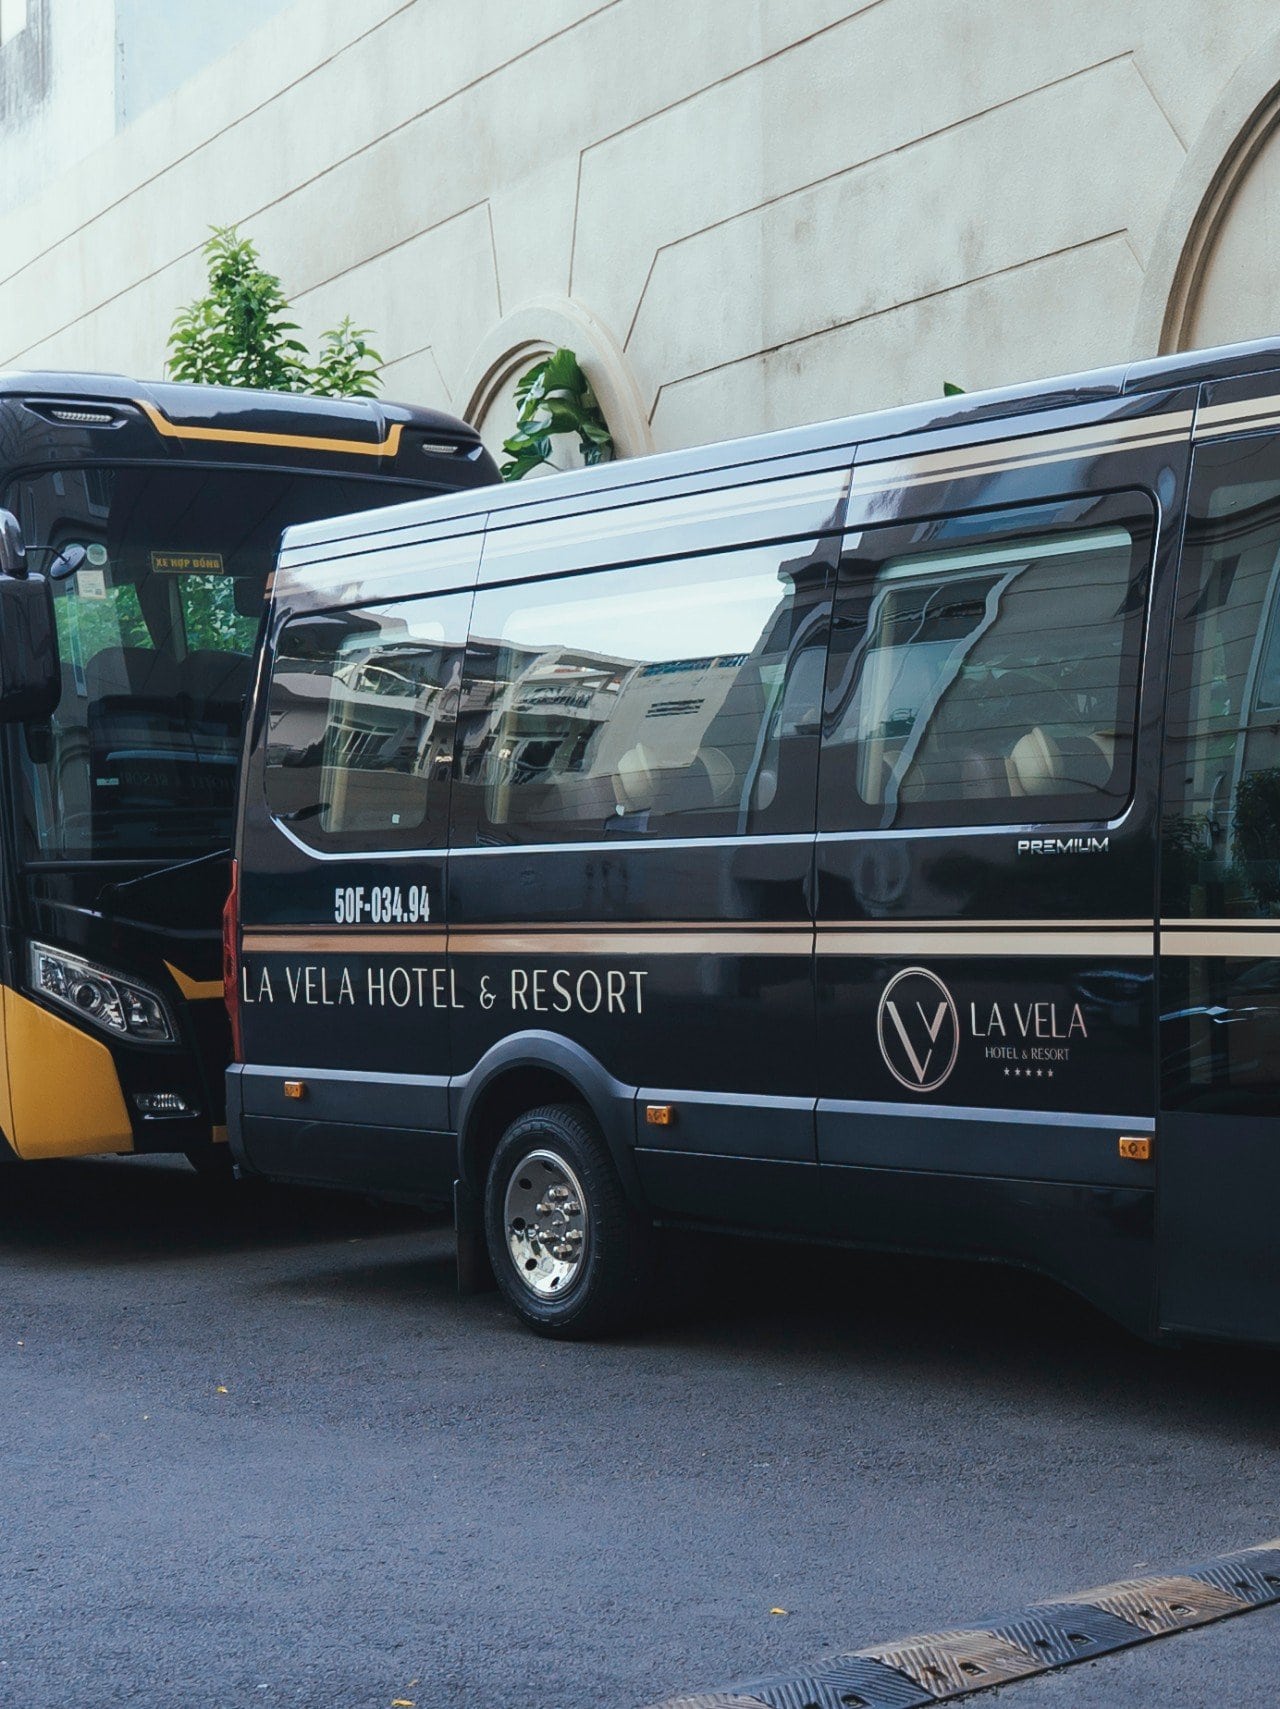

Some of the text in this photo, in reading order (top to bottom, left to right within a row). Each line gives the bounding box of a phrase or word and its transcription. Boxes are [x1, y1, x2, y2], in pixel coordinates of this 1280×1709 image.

[1017, 837, 1109, 855] PREMIUM
[334, 885, 430, 923] 50F-034.94
[242, 966, 648, 1014] LA VELA HOTEL & RESORT
[970, 1001, 1088, 1038] LA VELA
[985, 1046, 1070, 1061] HOTEL & RESORT
